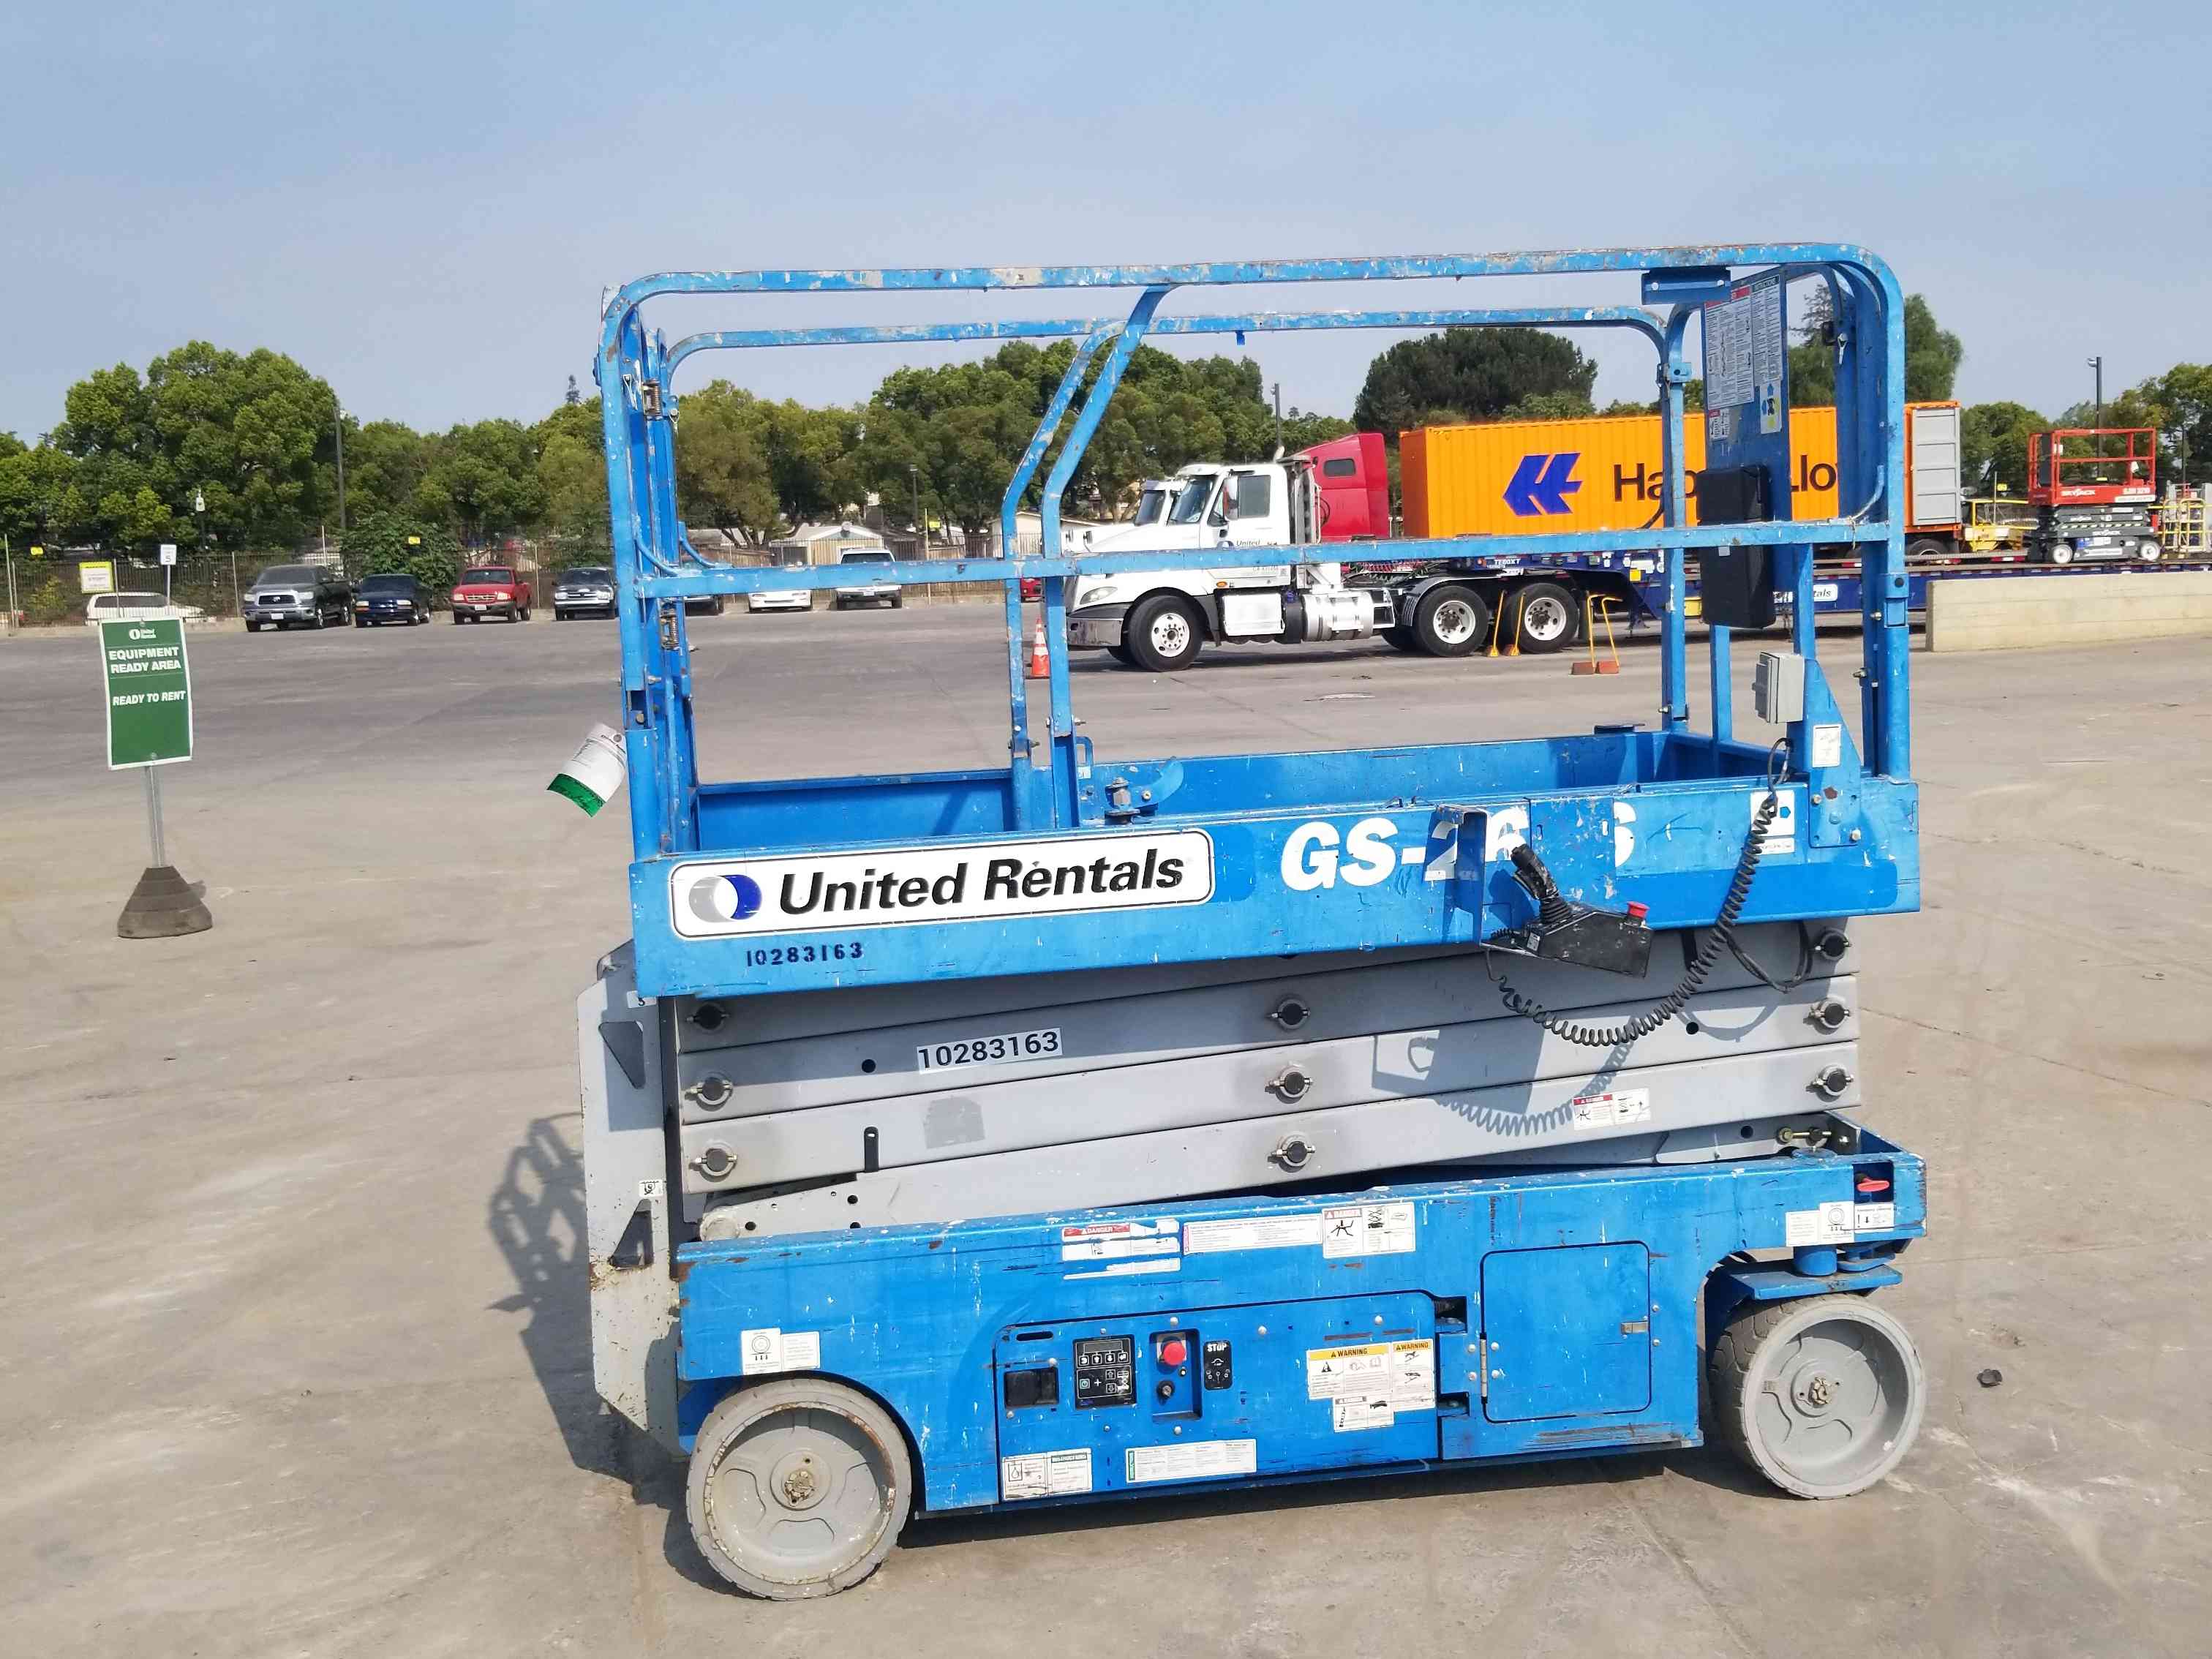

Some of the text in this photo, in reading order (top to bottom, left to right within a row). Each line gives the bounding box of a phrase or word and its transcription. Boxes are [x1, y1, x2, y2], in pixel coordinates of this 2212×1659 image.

[108, 647, 179, 661] EQUIPMENT
[110, 659, 182, 674] READY AREA
[112, 690, 187, 706] READY TO RENT
[779, 849, 1185, 915] United Rentals
[745, 942, 863, 967] 10283163
[918, 1031, 1059, 1071] 10283163
[1207, 1343, 1227, 1352] STOP
[1337, 1349, 1368, 1357] WARNING
[1396, 1342, 1429, 1350] WARNING
